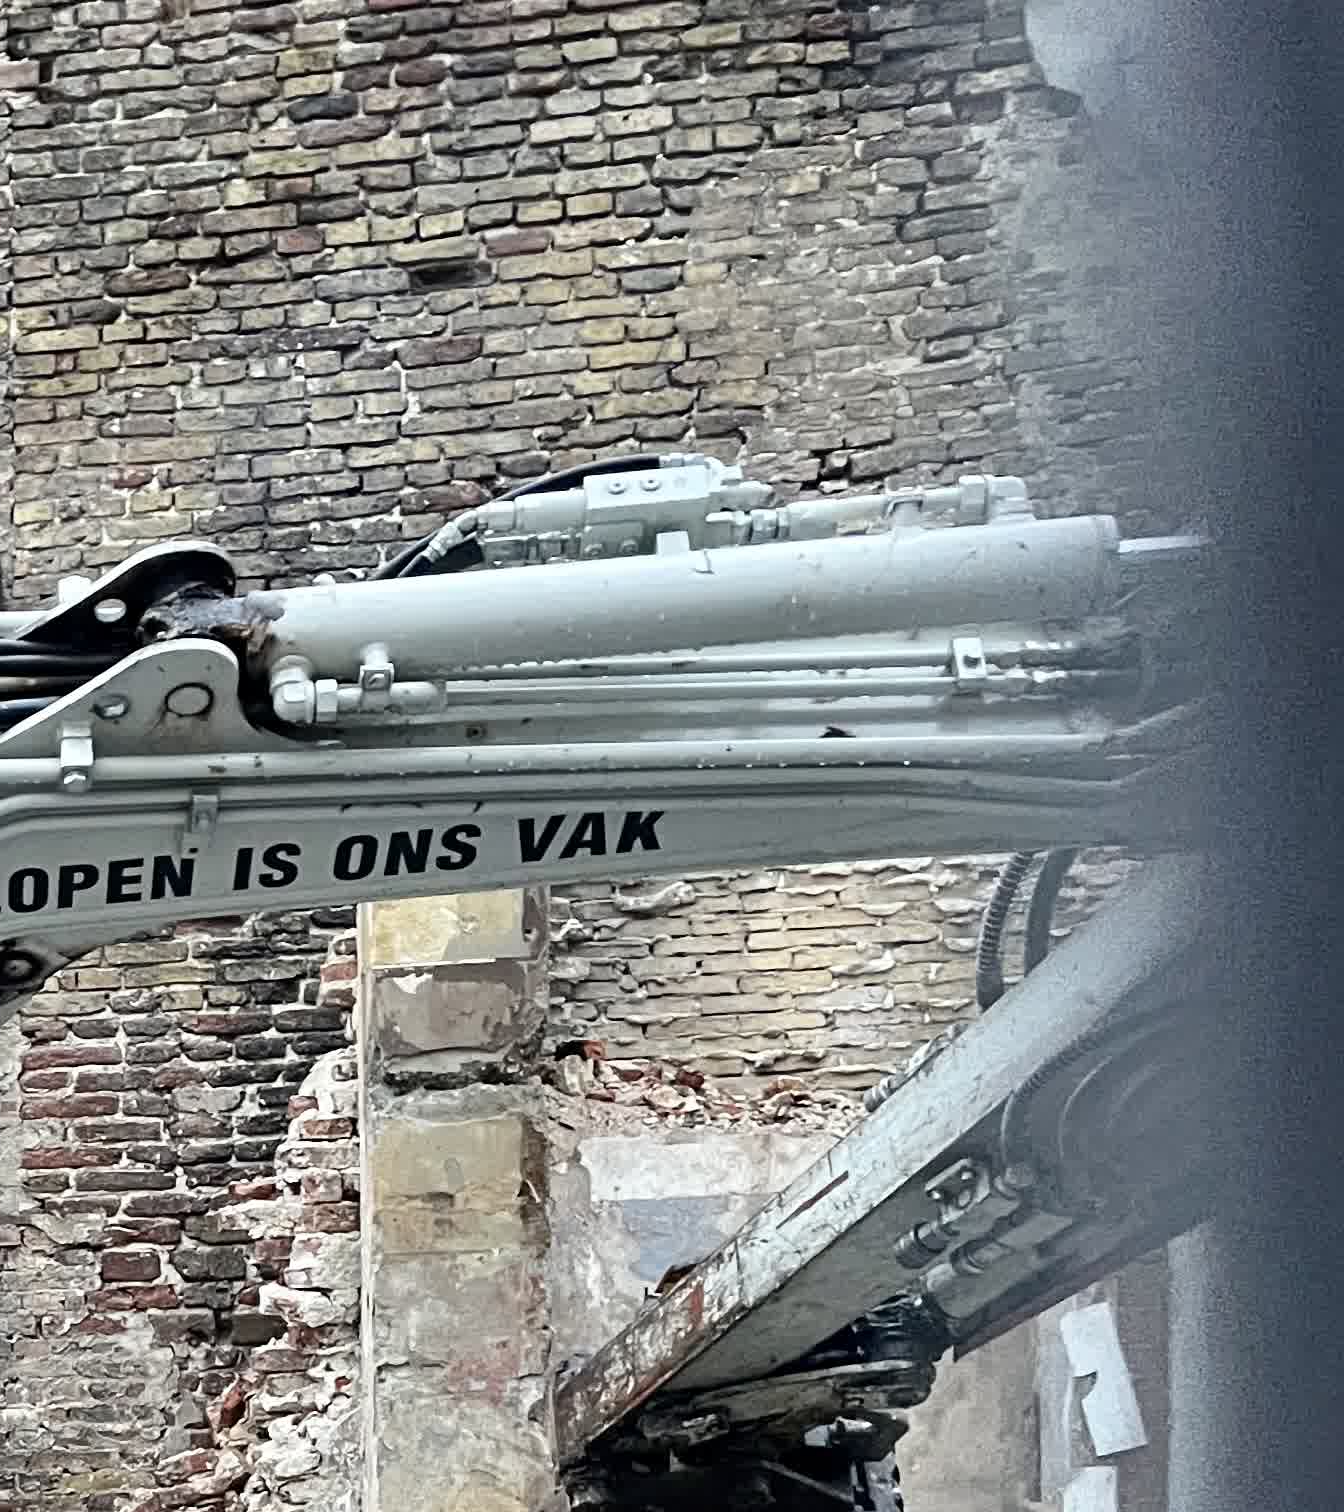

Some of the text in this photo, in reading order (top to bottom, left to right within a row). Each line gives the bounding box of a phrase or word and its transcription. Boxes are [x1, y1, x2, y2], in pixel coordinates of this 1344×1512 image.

[232, 842, 302, 892] IS
[332, 823, 483, 881] ONS
[518, 810, 666, 863] VAK
